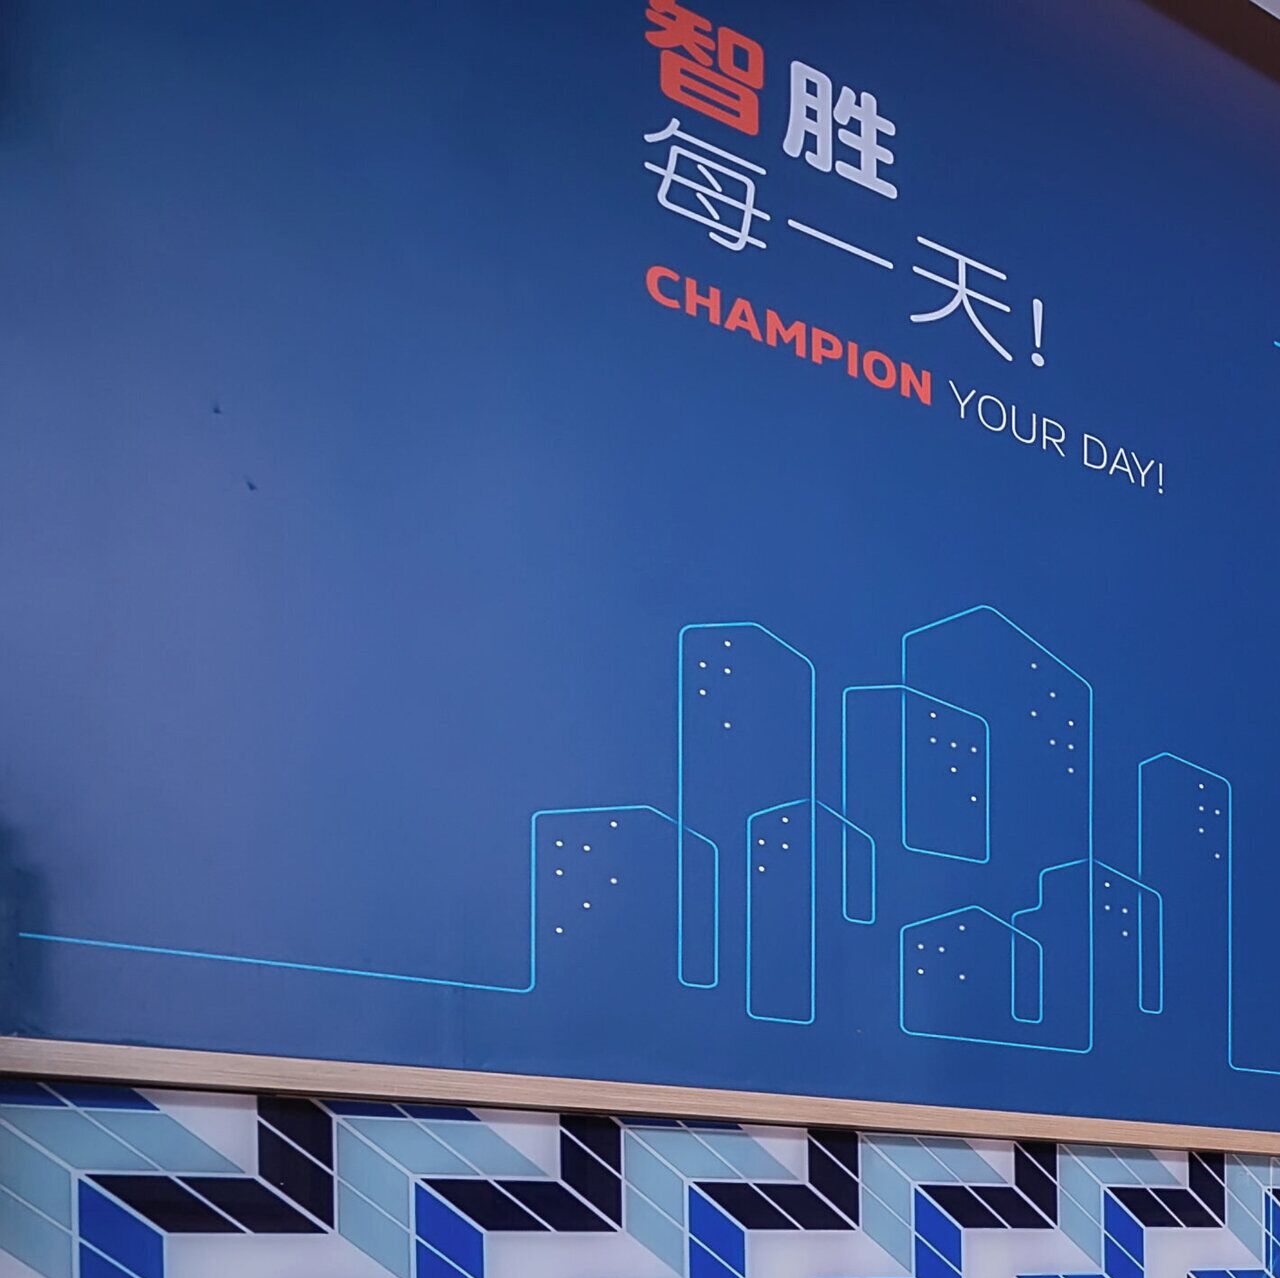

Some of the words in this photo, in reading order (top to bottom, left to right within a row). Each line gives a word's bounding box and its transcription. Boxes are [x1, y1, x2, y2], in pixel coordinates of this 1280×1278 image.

[645, 264, 932, 406] CHAMPION
[948, 379, 1066, 457] YOUR
[1082, 433, 1165, 494] DAY!
